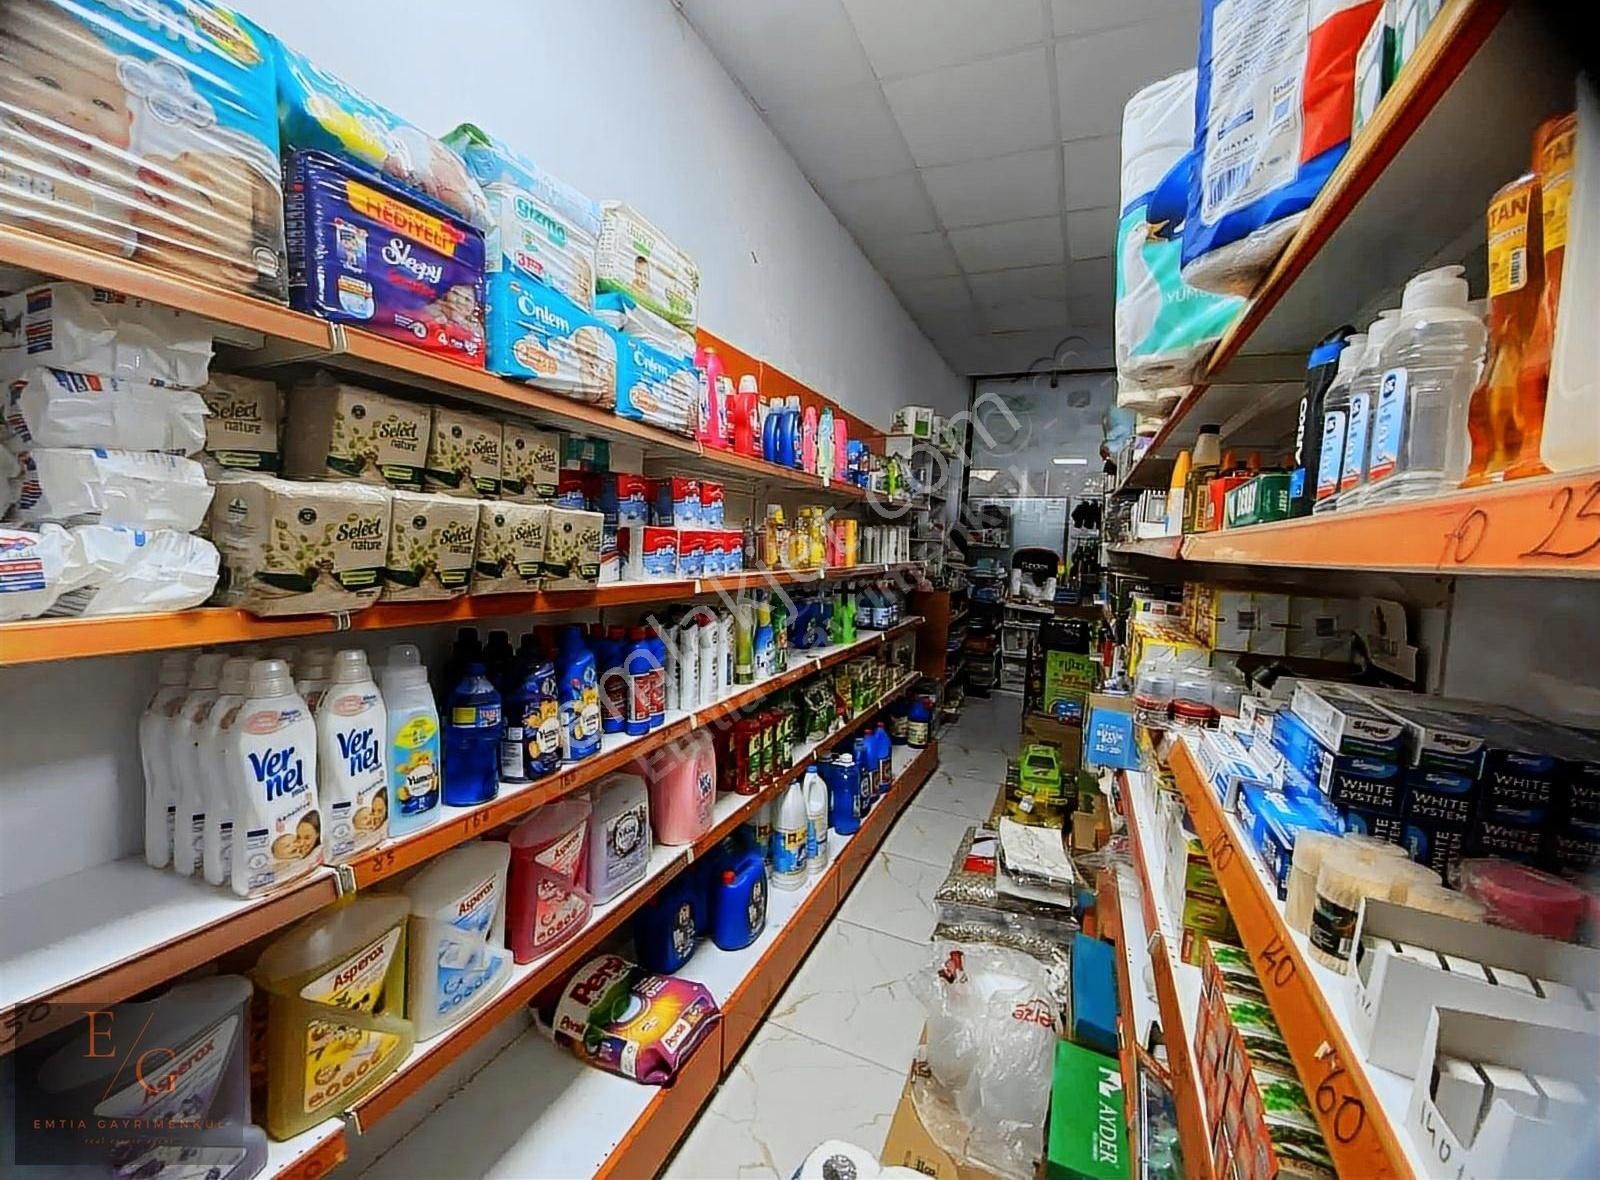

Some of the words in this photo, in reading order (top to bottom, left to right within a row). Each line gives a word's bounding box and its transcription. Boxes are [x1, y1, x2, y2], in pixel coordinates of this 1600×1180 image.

[516, 198, 567, 238] gizmo
[382, 238, 442, 283] Sleepy
[518, 291, 570, 333] Önlem
[634, 348, 669, 379] Önlem
[207, 401, 261, 420] Select
[224, 421, 261, 434] nature
[380, 422, 418, 440] Select
[390, 439, 417, 451] nature
[336, 520, 384, 541] Select
[440, 528, 474, 545] Select
[351, 539, 382, 551] nature
[1353, 720, 1390, 739] Signal
[337, 728, 373, 759] Ver
[1433, 734, 1471, 750] Signal
[248, 746, 295, 782] Ver
[350, 740, 379, 776] nel
[267, 760, 304, 801] nel
[1339, 775, 1396, 797] WHITE
[1494, 771, 1553, 792] WHITE
[1340, 789, 1393, 807] SYSTEM
[1412, 790, 1469, 811] WHITE
[1412, 804, 1467, 823] SYSTEM
[458, 881, 495, 916] Asperox
[333, 944, 384, 991] Asperox
[1099, 1100, 1119, 1166] AYDER
